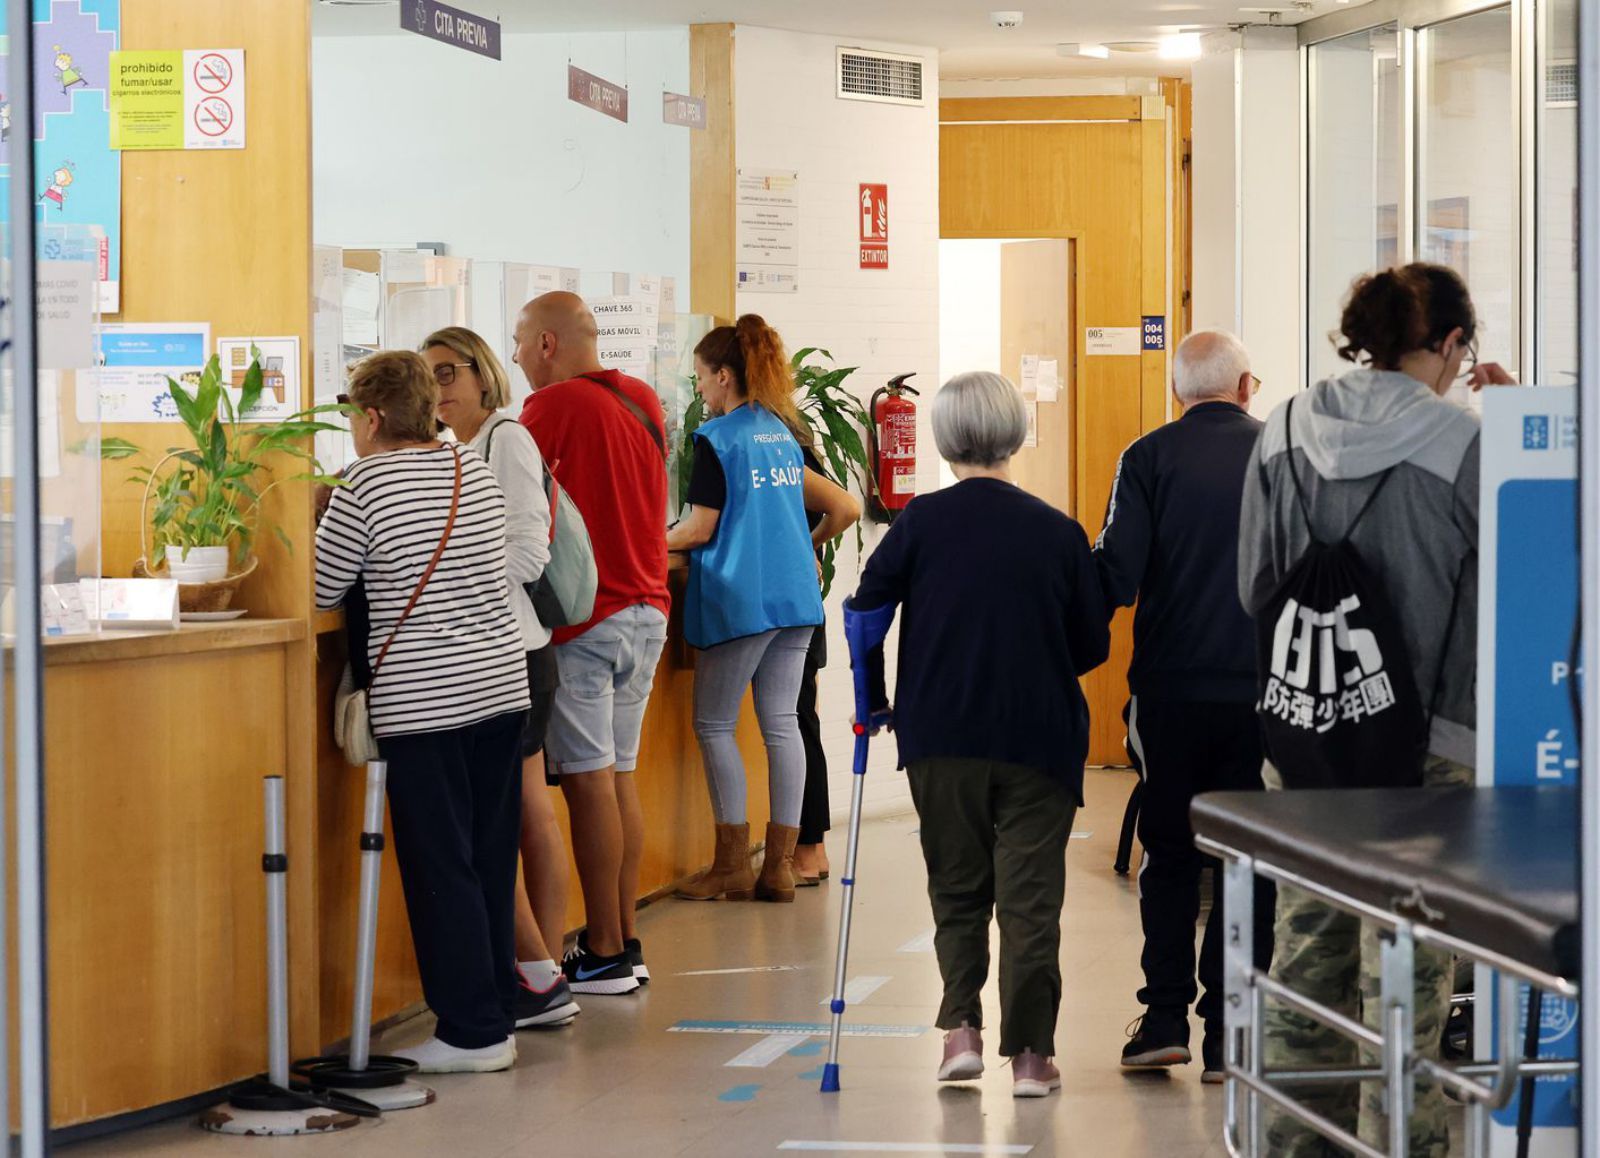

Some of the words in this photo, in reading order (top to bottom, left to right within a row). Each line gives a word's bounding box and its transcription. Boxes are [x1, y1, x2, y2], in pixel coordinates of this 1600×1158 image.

[435, 9, 454, 38] CITA
[456, 17, 488, 49] PREVIA
[121, 63, 173, 75] prohibido
[121, 77, 173, 87] fumar/usar
[861, 249, 888, 263] EXTINTOR
[593, 304, 618, 313] CHAVE
[597, 327, 617, 336] RGAS
[1144, 324, 1163, 333] 004
[1088, 329, 1103, 339] 005
[1144, 335, 1163, 344] 005
[1263, 671, 1396, 734] 防彈少年團
